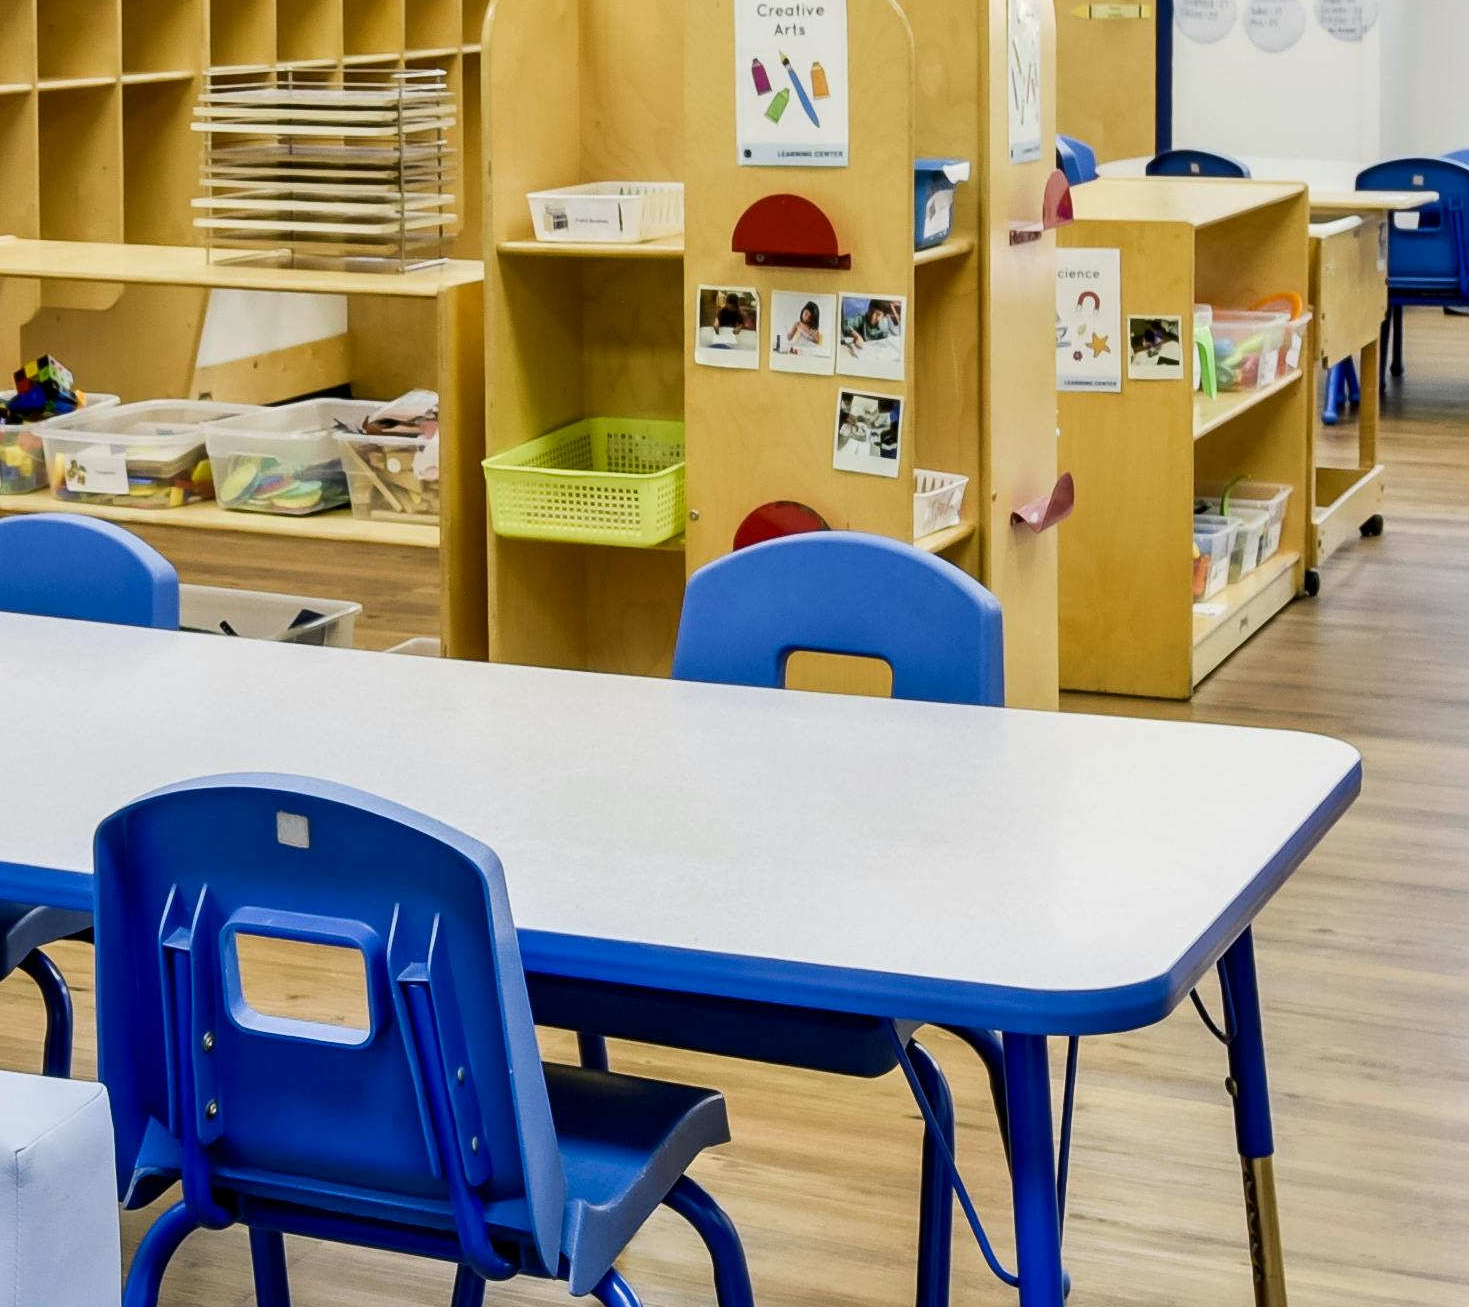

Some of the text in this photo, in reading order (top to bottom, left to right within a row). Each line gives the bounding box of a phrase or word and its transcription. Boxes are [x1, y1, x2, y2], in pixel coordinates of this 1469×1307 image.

[756, 3, 825, 18] Creative
[774, 22, 806, 36] Arts
[814, 150, 843, 158] CENTER
[1057, 268, 1100, 279] cience
